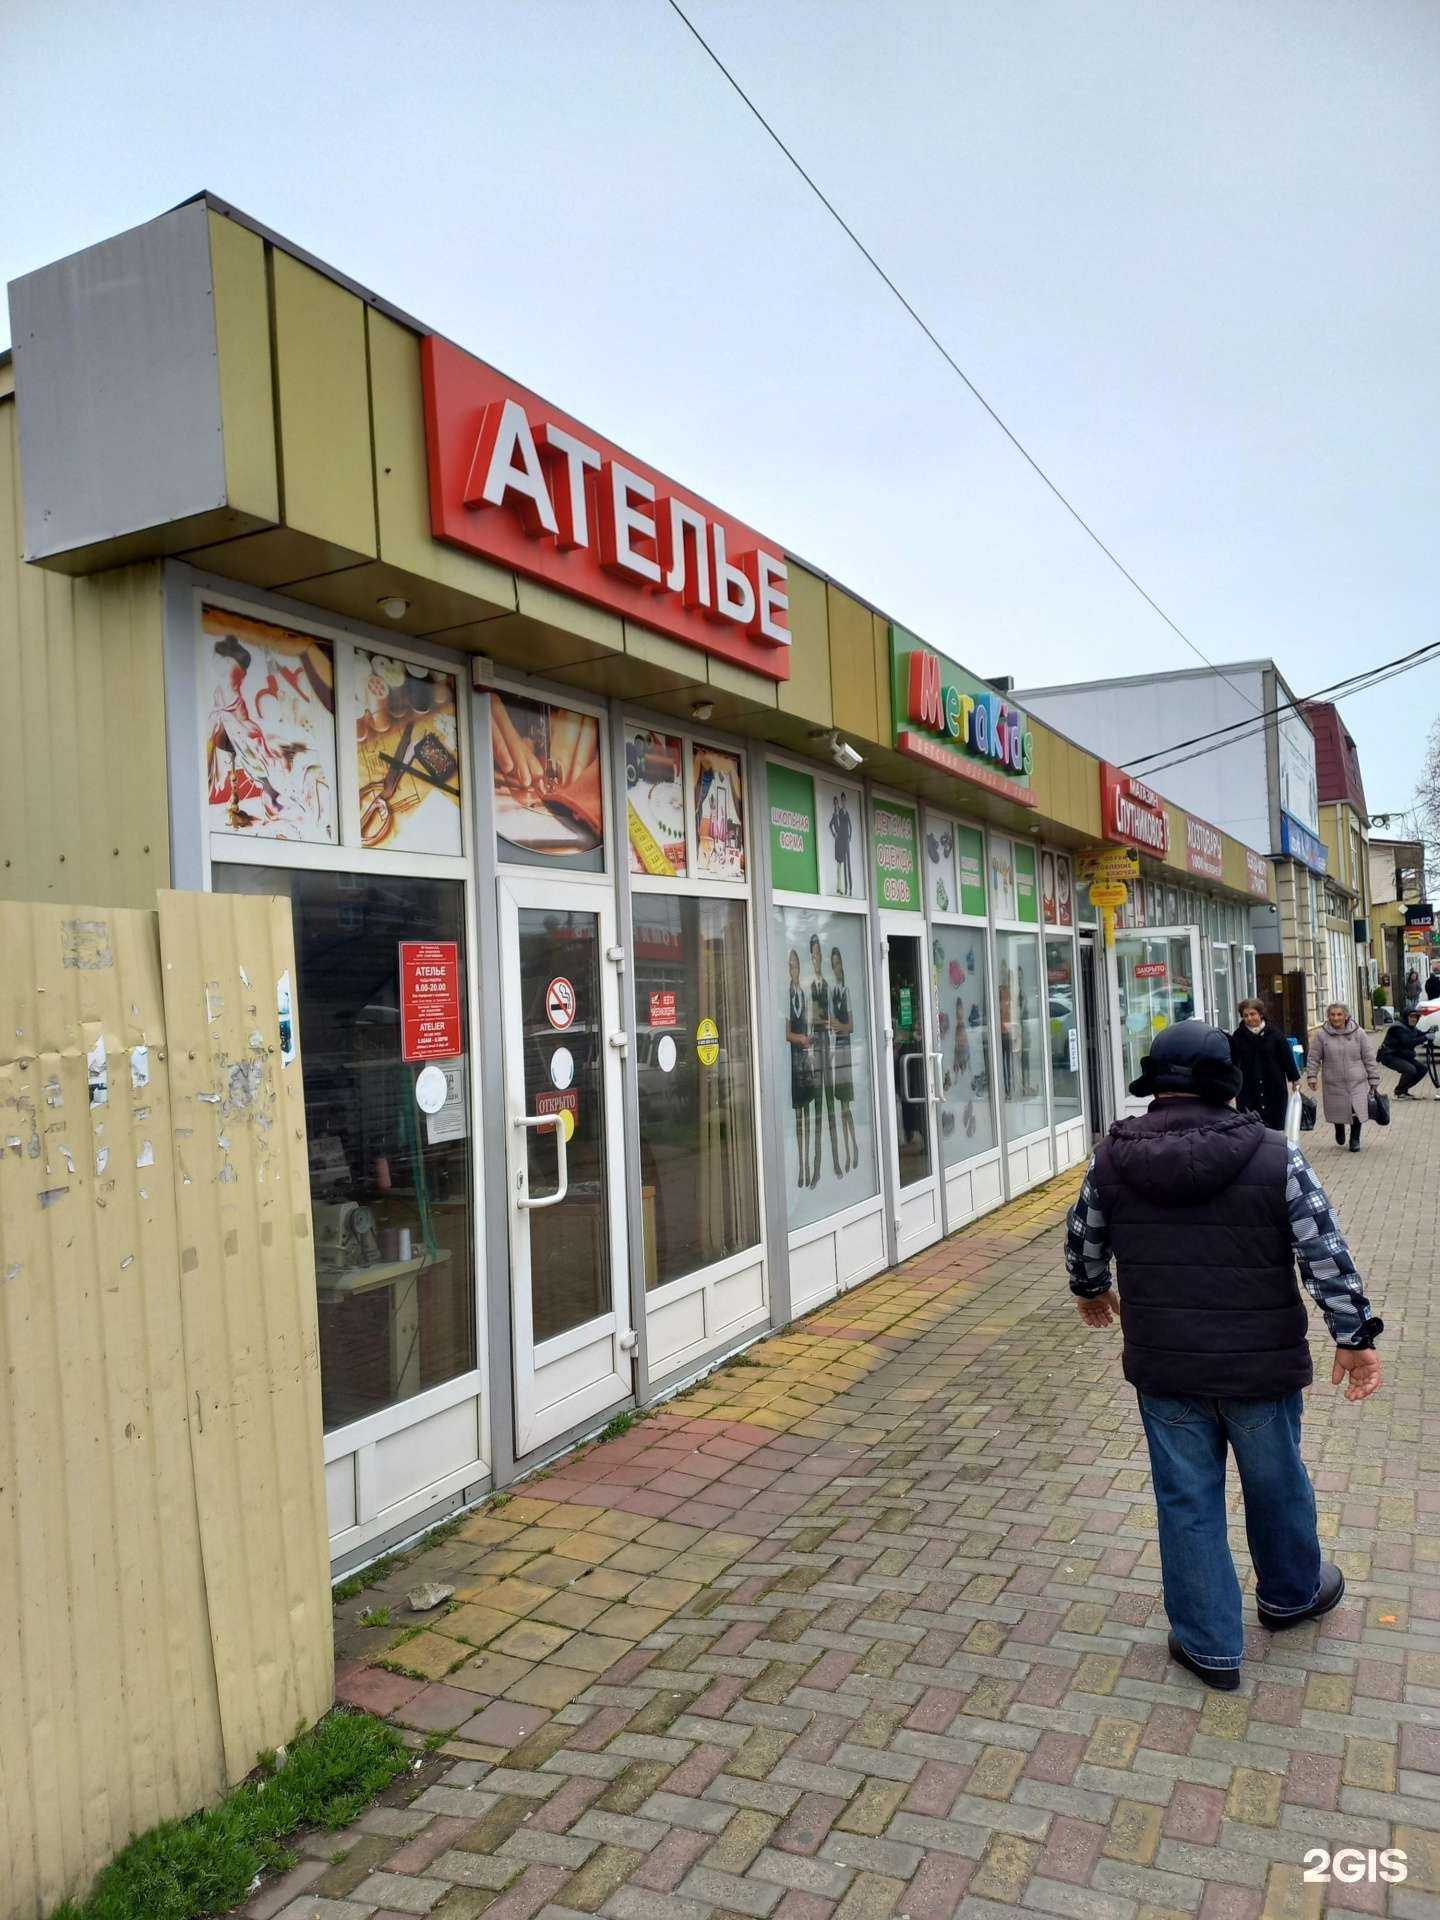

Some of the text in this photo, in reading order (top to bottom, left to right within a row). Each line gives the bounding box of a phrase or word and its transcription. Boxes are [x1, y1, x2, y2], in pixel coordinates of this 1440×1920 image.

[480, 397, 793, 647] АТЕЛЬЕ
[415, 966, 446, 977] АТЕЛЬЕ
[1136, 965, 1166, 975] ЗАКРЫТО
[420, 1021, 446, 1032] ATELIER
[539, 1095, 576, 1114] ОТКРЫТО
